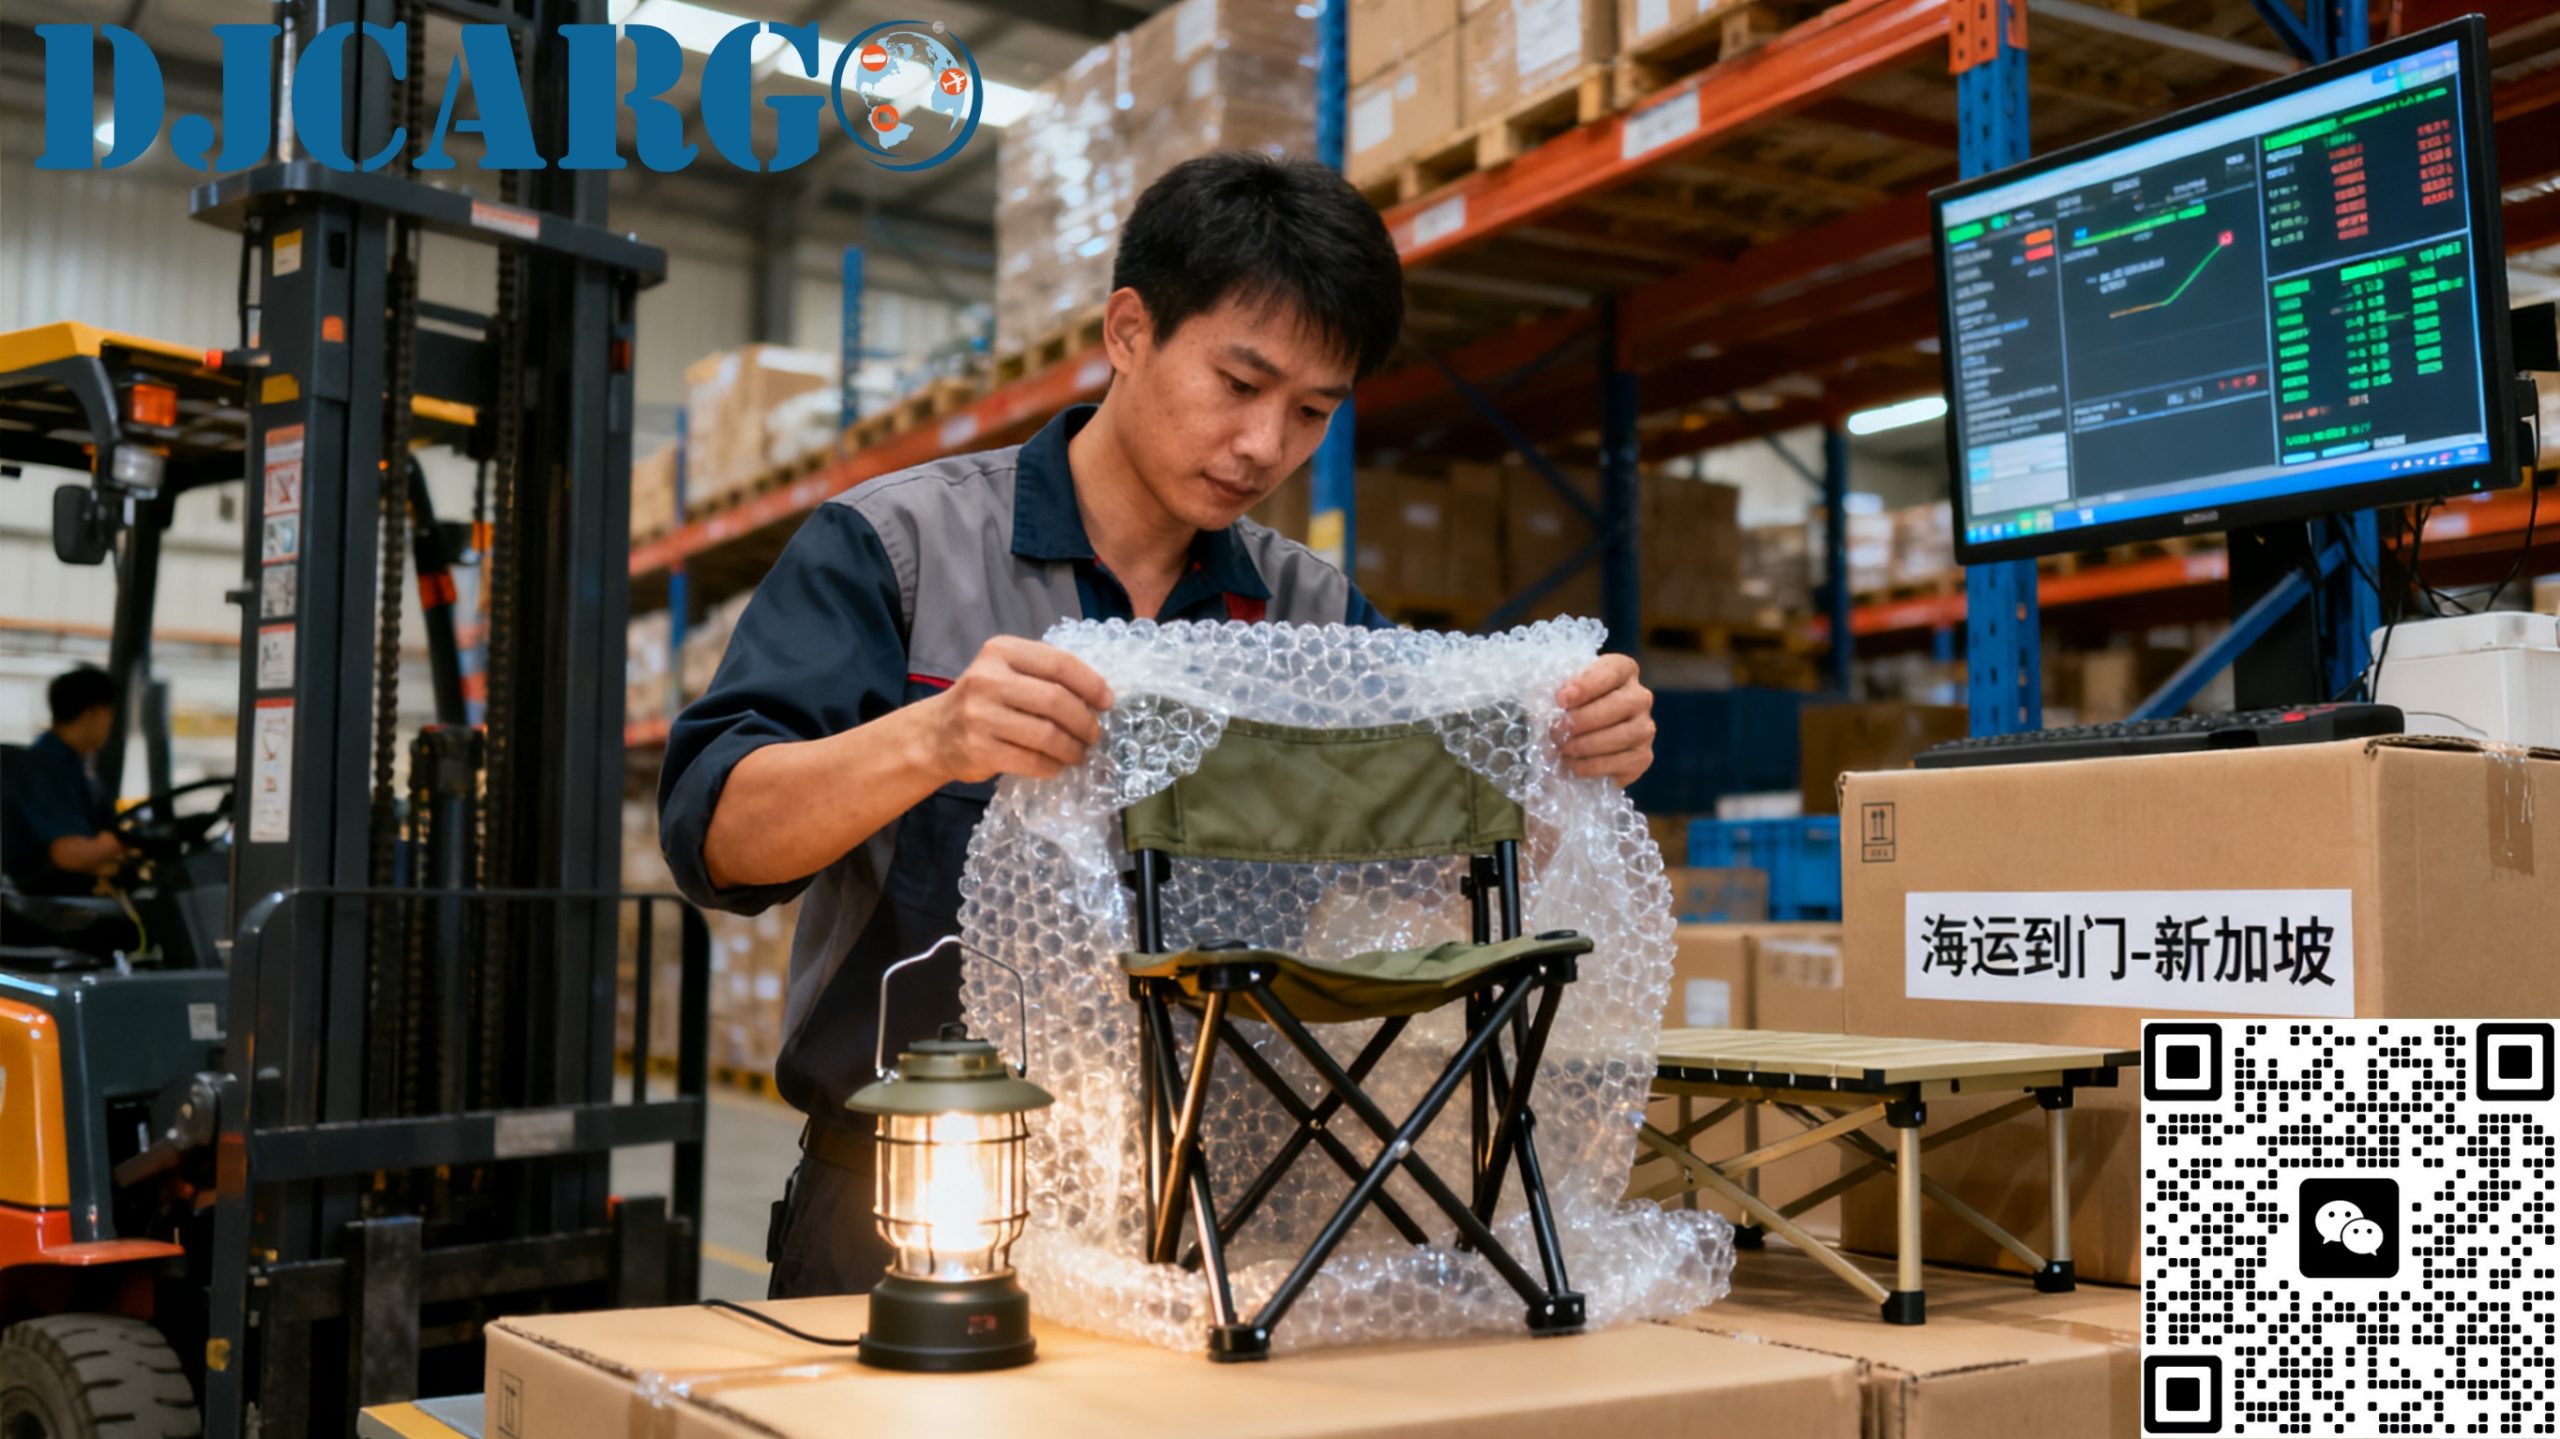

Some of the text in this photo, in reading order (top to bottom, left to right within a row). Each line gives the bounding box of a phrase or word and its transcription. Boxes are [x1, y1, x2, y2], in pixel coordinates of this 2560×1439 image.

[1920, 913, 2336, 986] 海运到门-新加坡
